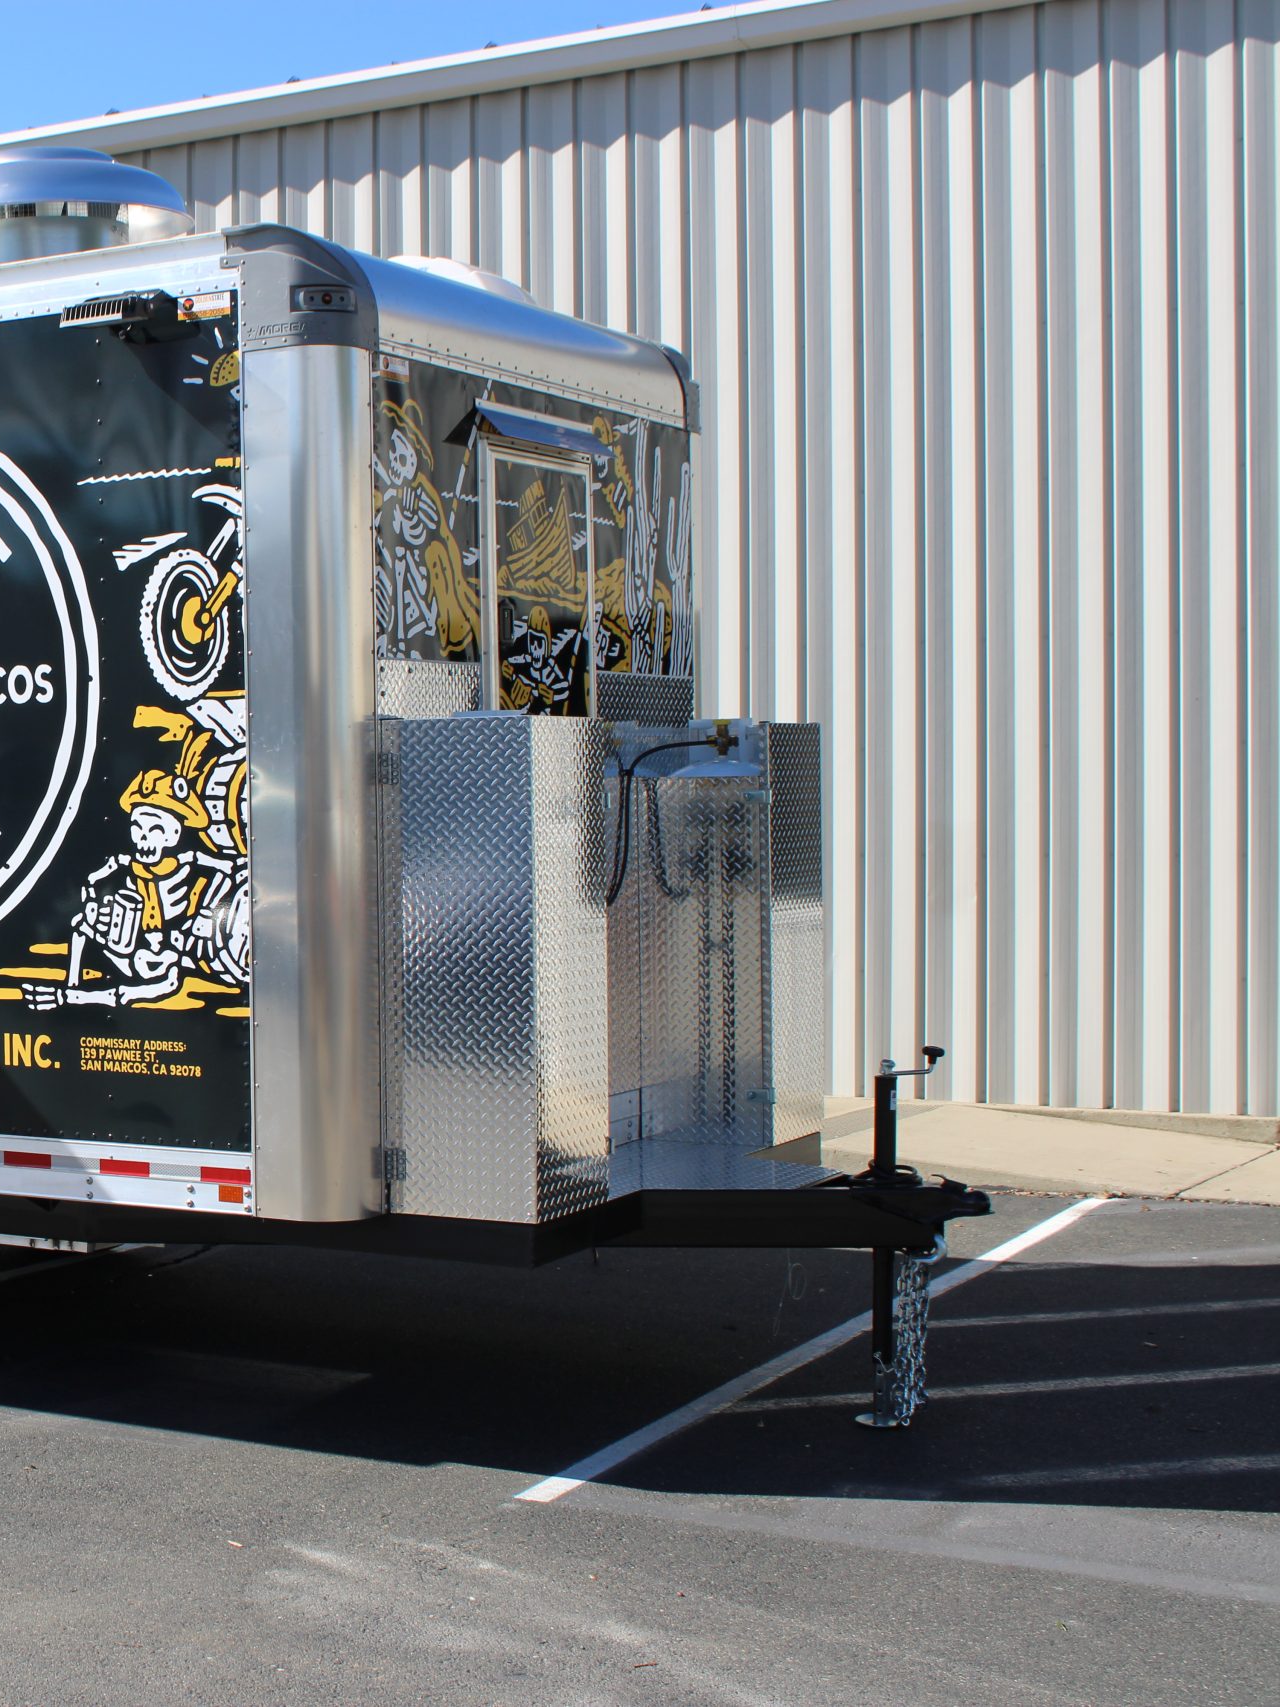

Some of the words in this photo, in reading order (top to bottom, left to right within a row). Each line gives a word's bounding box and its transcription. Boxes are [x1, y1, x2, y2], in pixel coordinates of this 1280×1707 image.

[4, 1033, 61, 1069] INC.
[80, 1037, 141, 1050] COMMISSARY
[143, 1040, 187, 1053] ADDRESS:
[80, 1048, 97, 1059] 139
[99, 1049, 141, 1062] PAWNEE
[80, 1060, 101, 1072] SAN
[152, 1064, 168, 1076] CA
[170, 1065, 202, 1078] 92078
